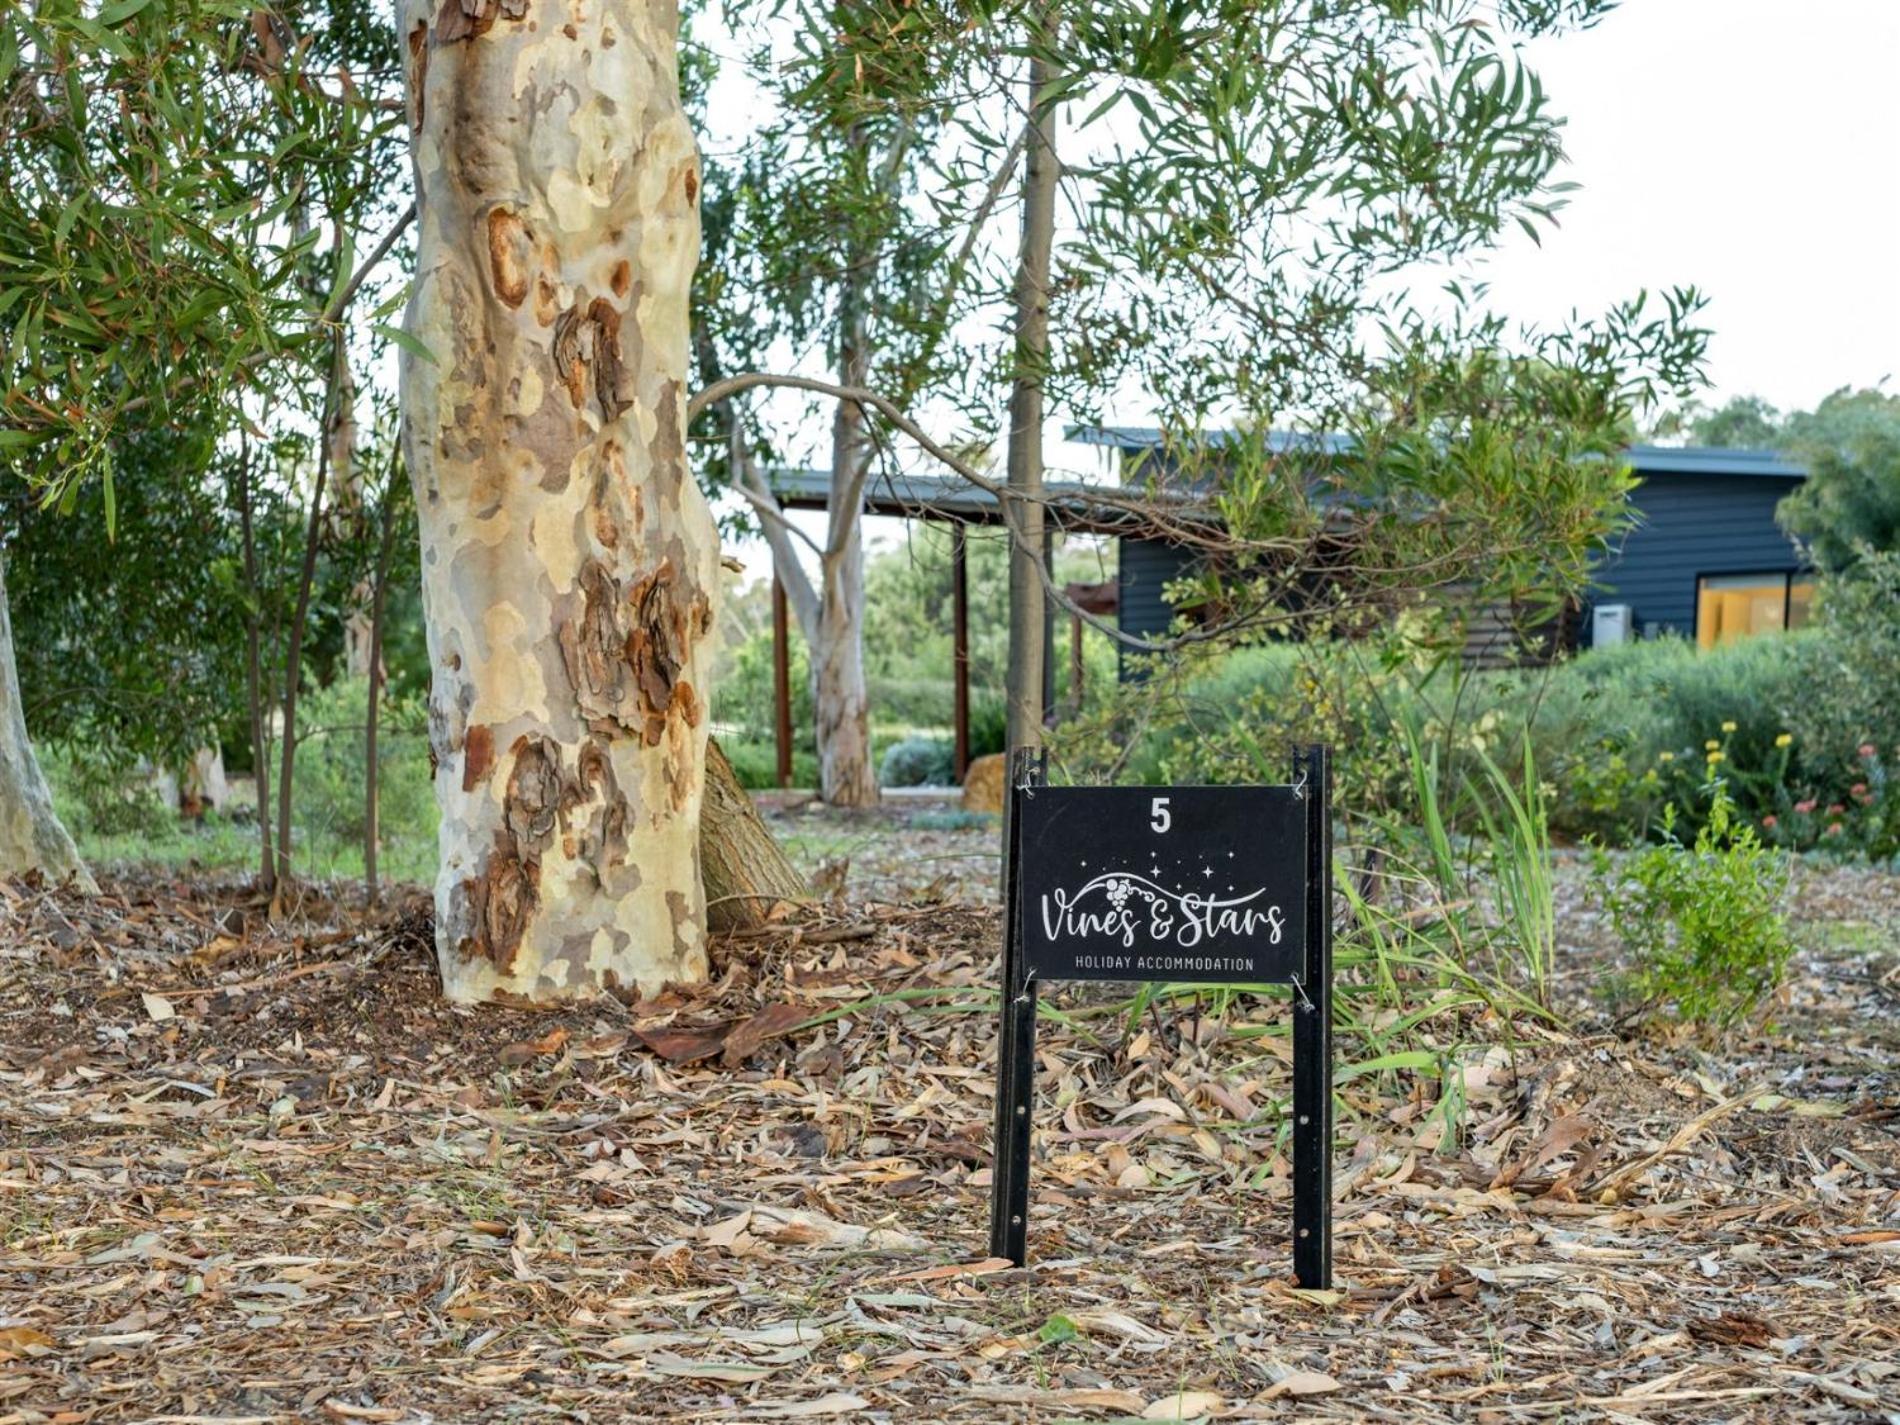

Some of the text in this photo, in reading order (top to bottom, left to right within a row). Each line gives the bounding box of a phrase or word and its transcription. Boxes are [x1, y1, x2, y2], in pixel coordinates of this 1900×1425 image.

[1150, 797, 1172, 833] 5
[1041, 888, 1286, 948] Vines & Stars
[1075, 955, 1254, 971] HOLIDAY ACCOMMODATION
